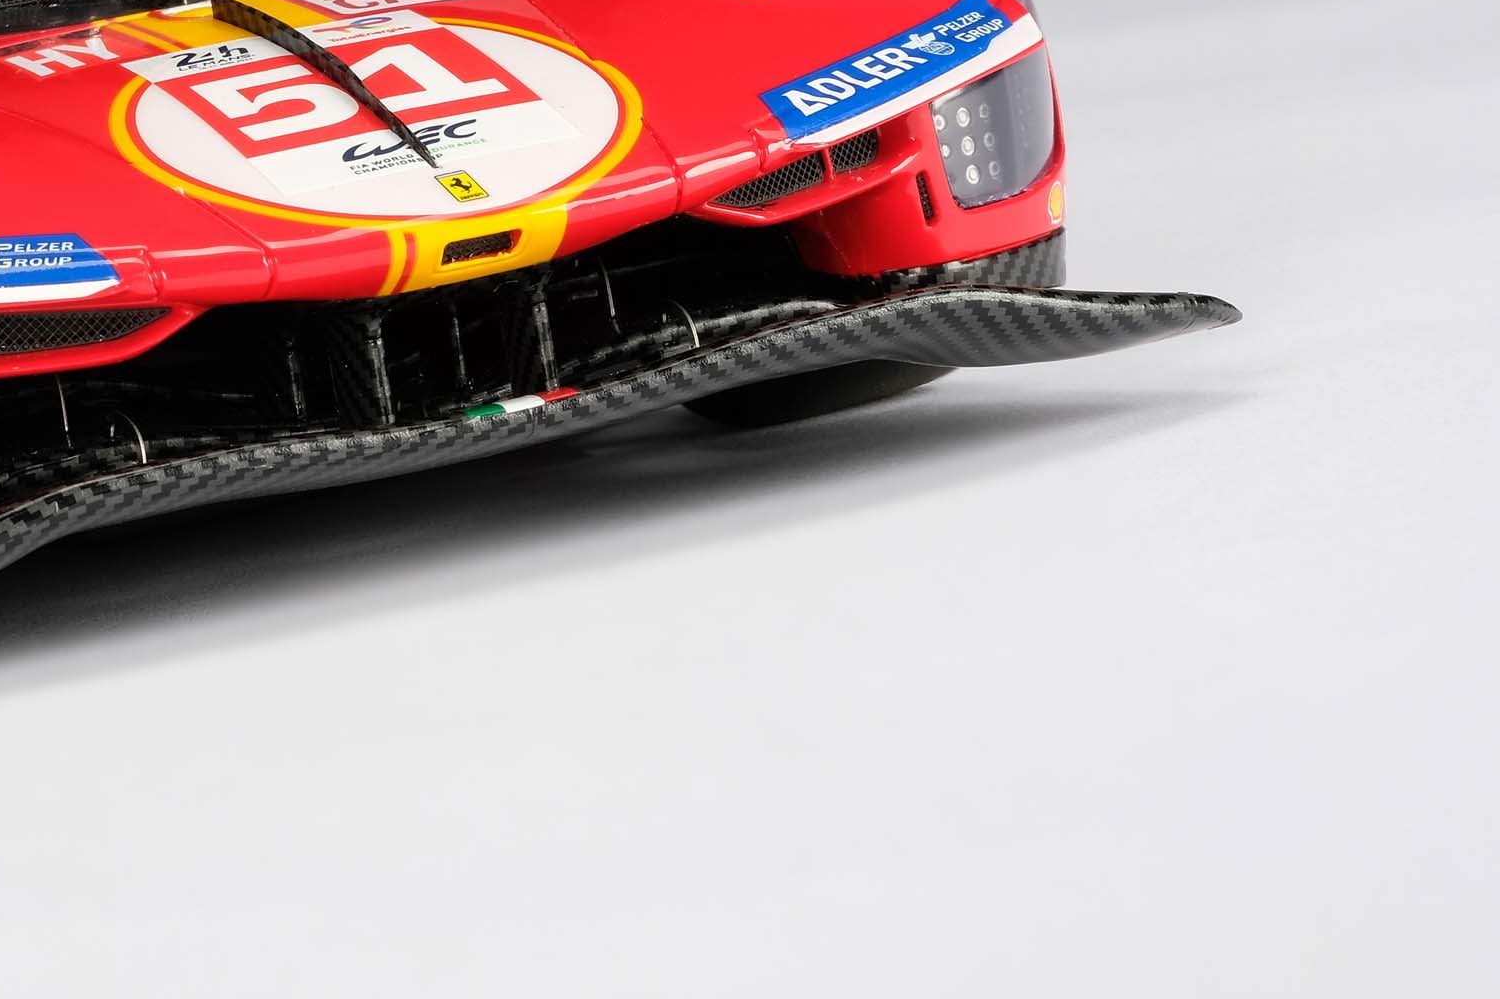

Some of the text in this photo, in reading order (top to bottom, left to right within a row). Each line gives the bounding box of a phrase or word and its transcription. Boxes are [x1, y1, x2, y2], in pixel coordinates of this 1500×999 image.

[933, 11, 986, 37] PELZER
[954, 18, 1005, 43] GROUP
[4, 36, 122, 78] HY
[189, 43, 510, 142] 51
[782, 46, 929, 117] ADLER
